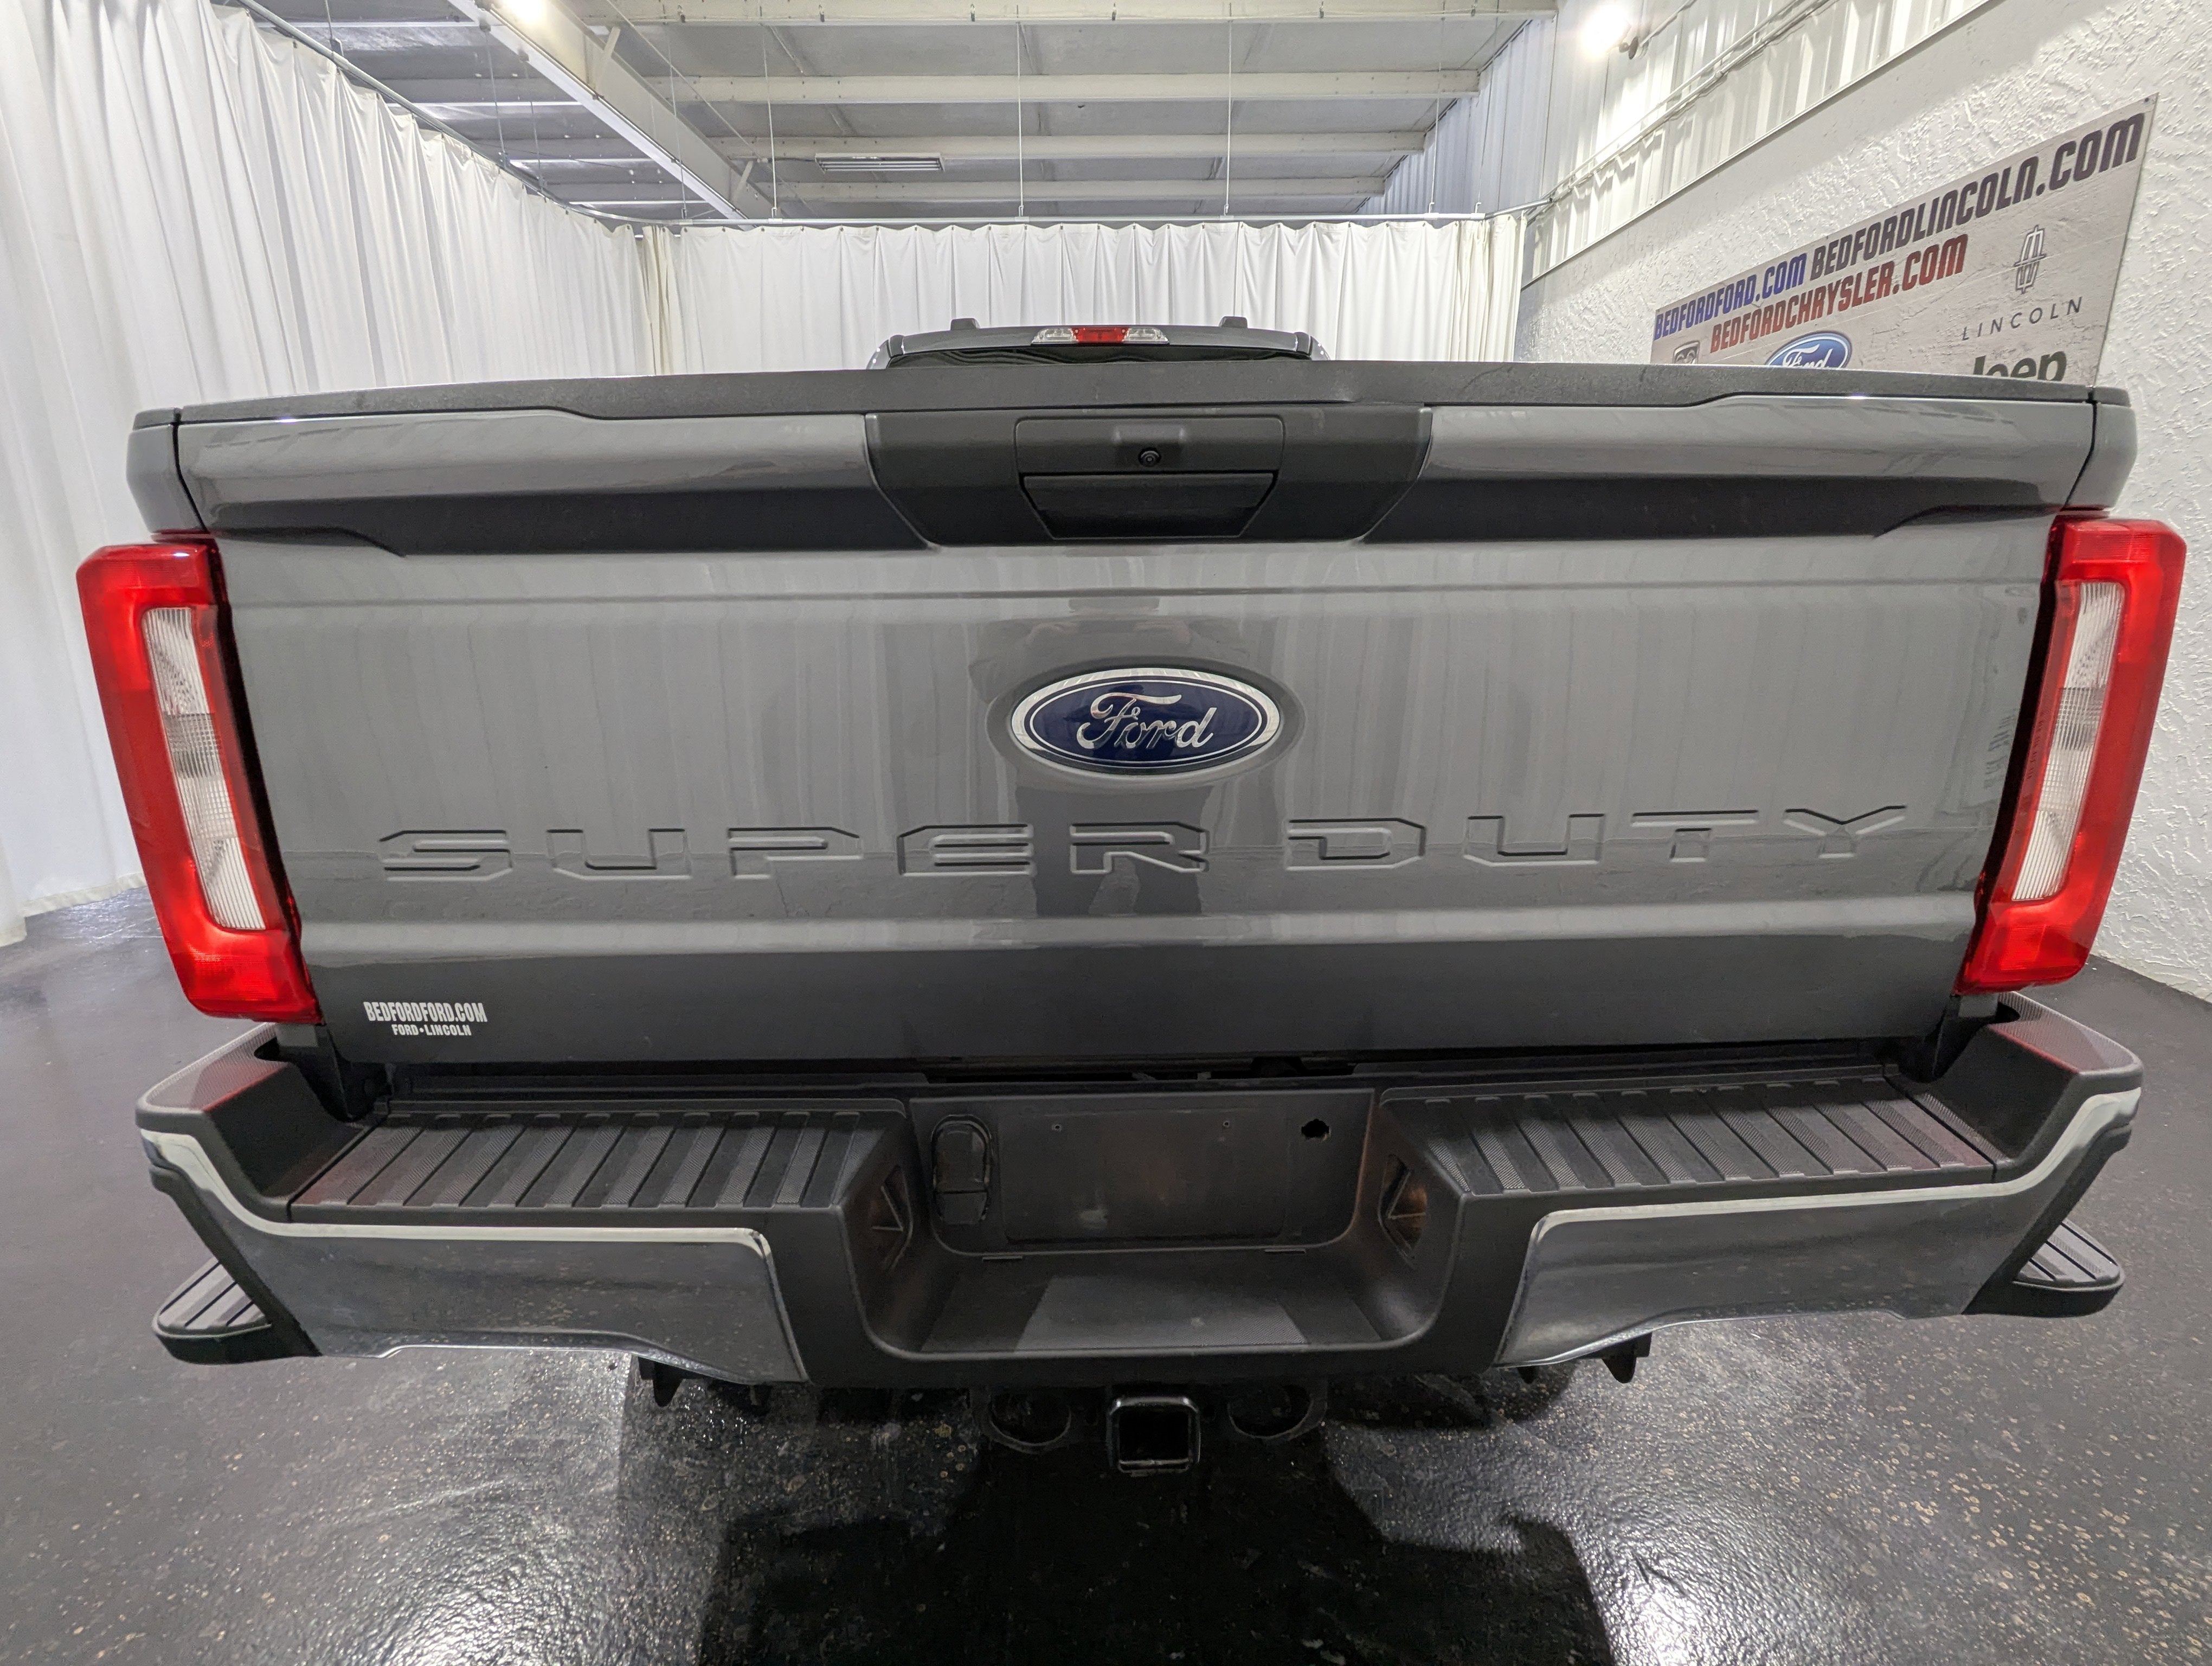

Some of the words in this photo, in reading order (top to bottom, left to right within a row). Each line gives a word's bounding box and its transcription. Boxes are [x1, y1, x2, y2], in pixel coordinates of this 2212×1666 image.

[1654, 253, 1807, 341] BEDFORDFORD.COM
[1810, 112, 2146, 281] BEDFORDLINCOLN.COM
[1711, 234, 1969, 353] BEDFORDCHRYSLER.COM
[1962, 296, 2083, 341] LINCOLN
[1076, 692, 1217, 749] Ford
[378, 821, 1209, 881] SUPER
[1285, 805, 1907, 870] DUTY
[363, 1002, 488, 1022] BEDFORDFORD.COM
